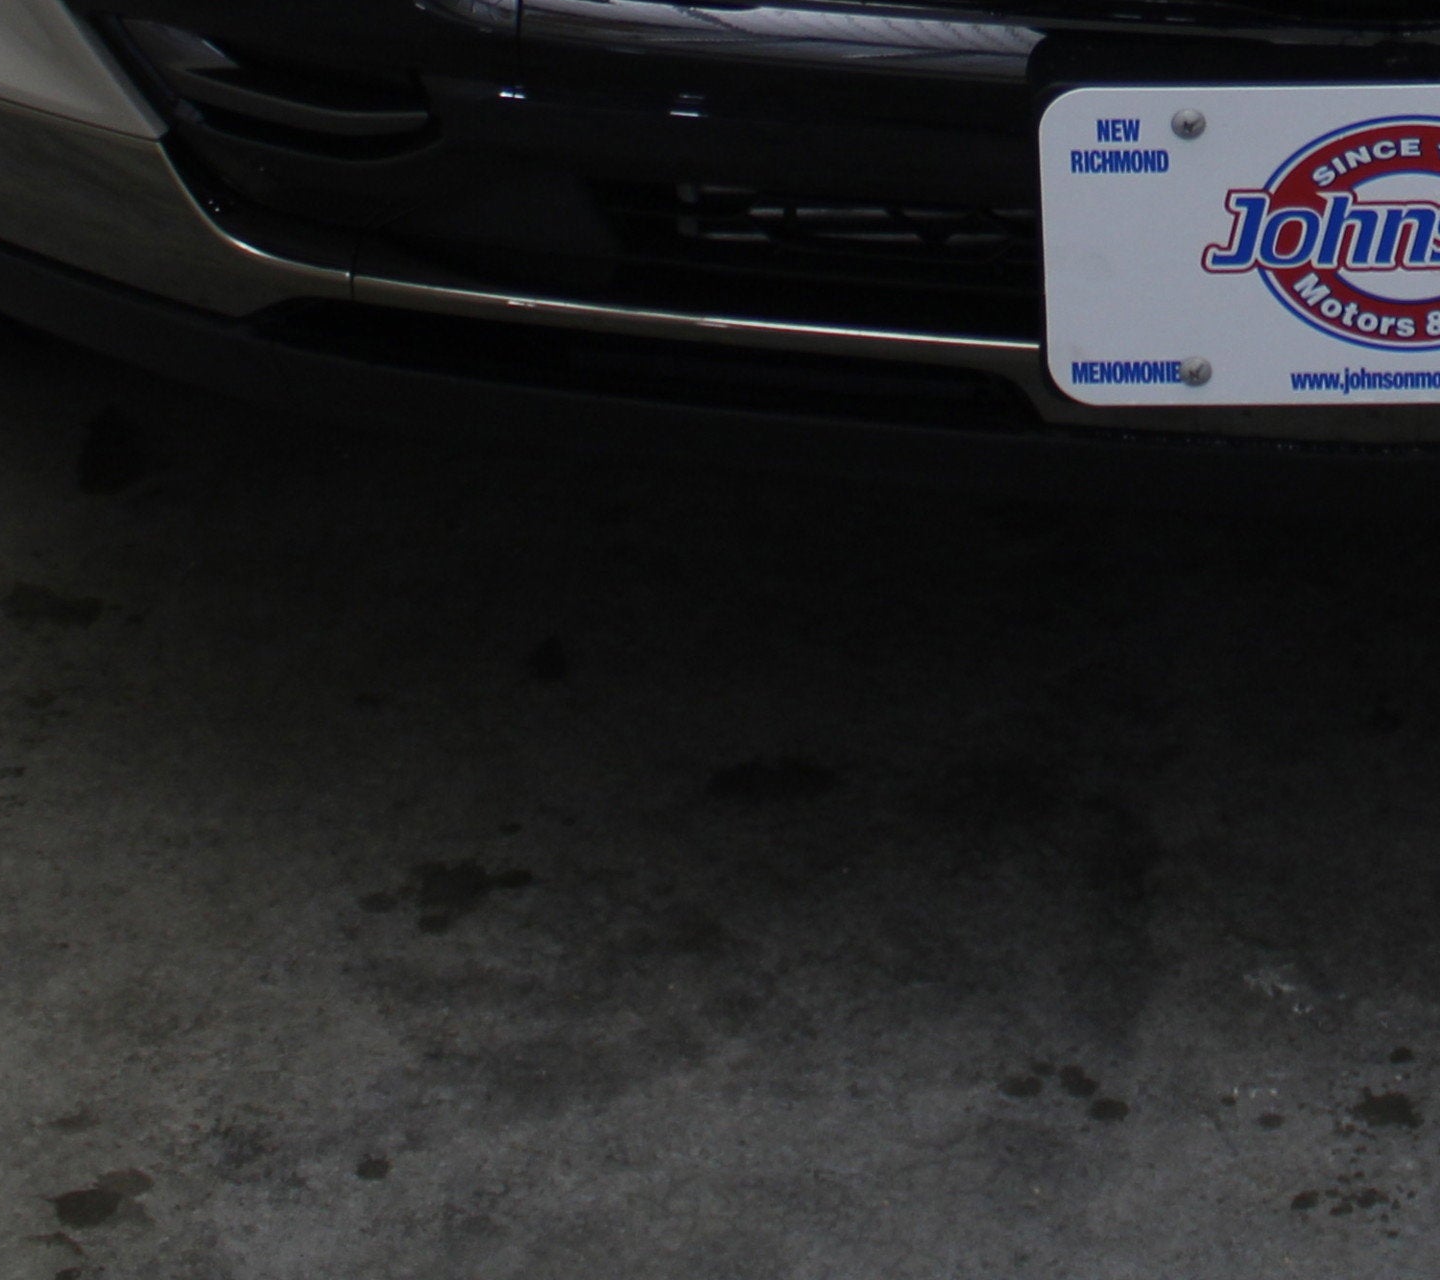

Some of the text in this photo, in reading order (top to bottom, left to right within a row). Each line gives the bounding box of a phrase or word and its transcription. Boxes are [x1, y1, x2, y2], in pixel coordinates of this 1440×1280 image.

[1096, 118, 1141, 143] NEW
[1070, 149, 1170, 174] RICHMOND
[1312, 137, 1422, 188] SINCE
[1292, 272, 1417, 338] Motors
[1071, 361, 1183, 384] MENOMONIE
